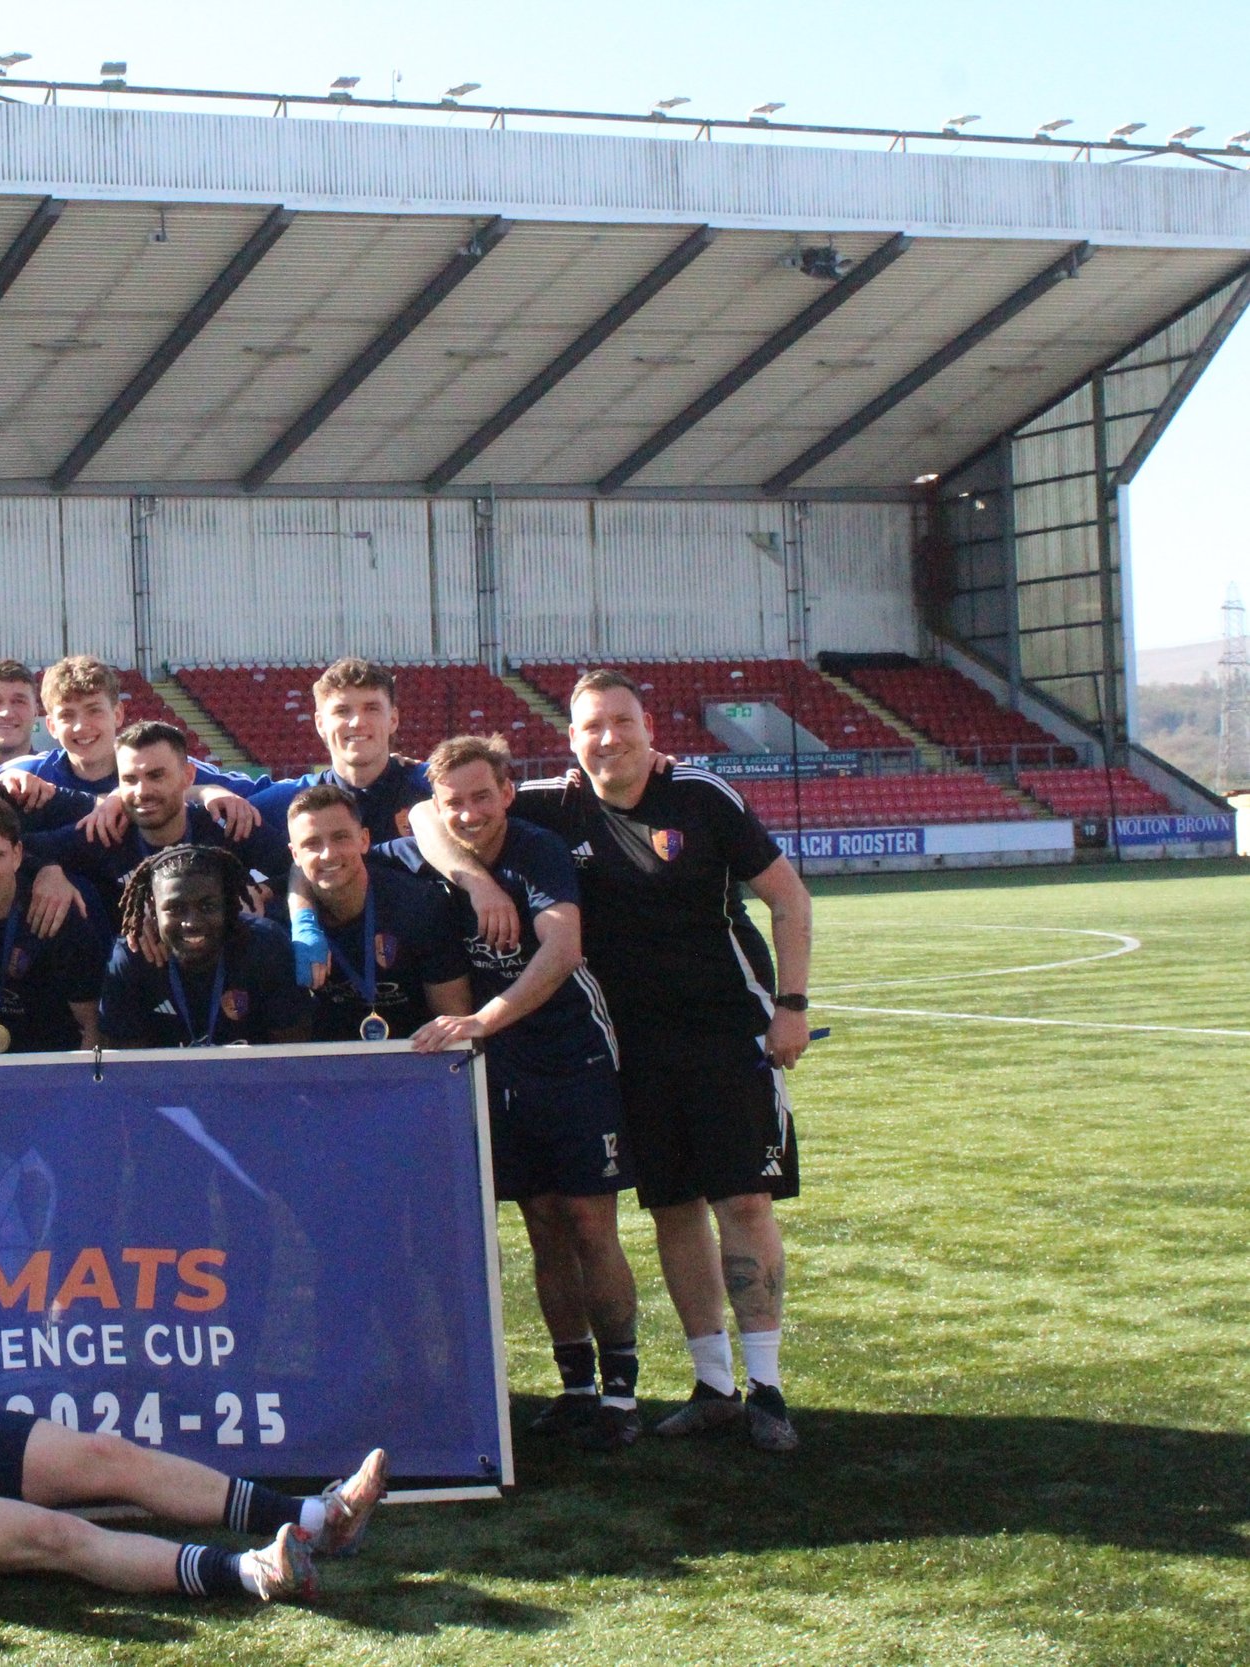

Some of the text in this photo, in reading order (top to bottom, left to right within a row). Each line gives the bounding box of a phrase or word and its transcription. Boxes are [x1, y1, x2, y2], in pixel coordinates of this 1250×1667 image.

[716, 756, 740, 765] AUTO
[796, 754, 823, 763] EPAIR
[824, 752, 858, 762] CENTRE
[716, 765, 743, 774] 01236
[1116, 816, 1231, 836] MOLTON BROWN
[775, 832, 918, 857] BLACK ROOSTER
[602, 1132, 619, 1158] 12
[765, 1145, 782, 1159] ZC
[142, 1323, 235, 1367] CUP
